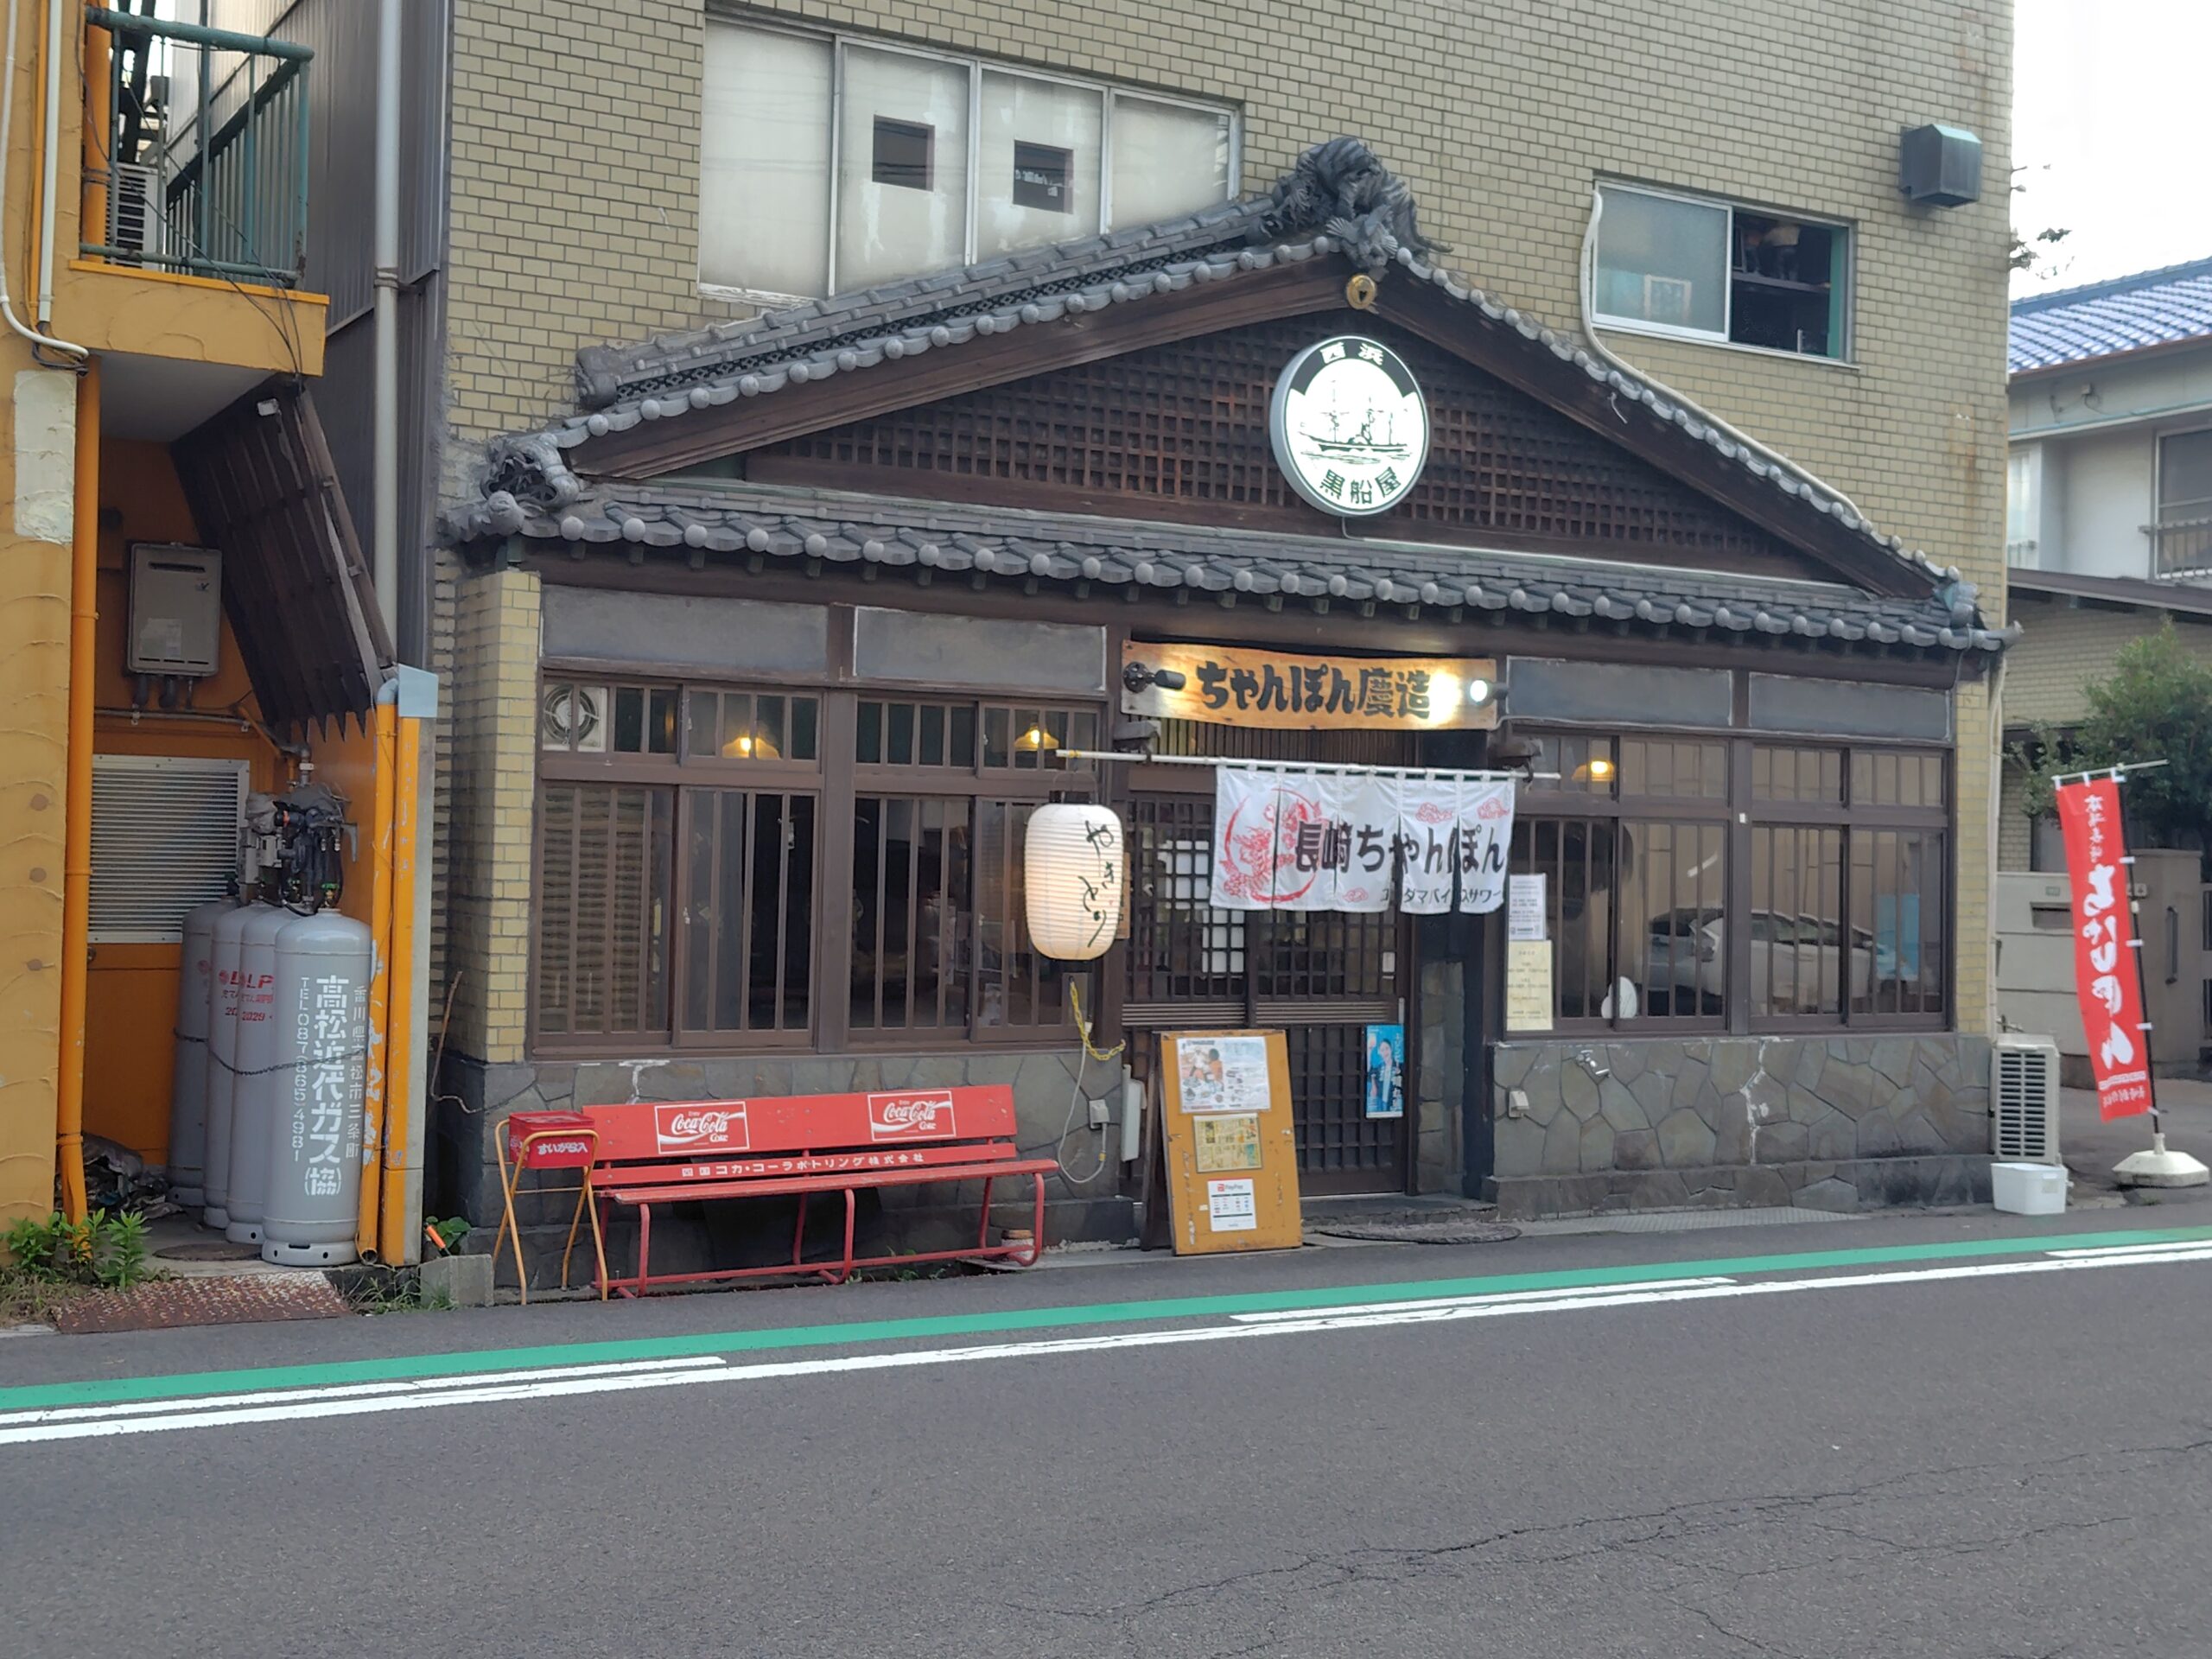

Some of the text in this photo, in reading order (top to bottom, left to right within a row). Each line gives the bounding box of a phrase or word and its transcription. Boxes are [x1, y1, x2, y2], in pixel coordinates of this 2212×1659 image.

[1319, 467, 1402, 504] 黒船屋
[1295, 820, 1505, 874] 長崎ちゃんぽん
[1078, 820, 1115, 948] やきとり
[671, 1111, 728, 1135] Coca-Cola
